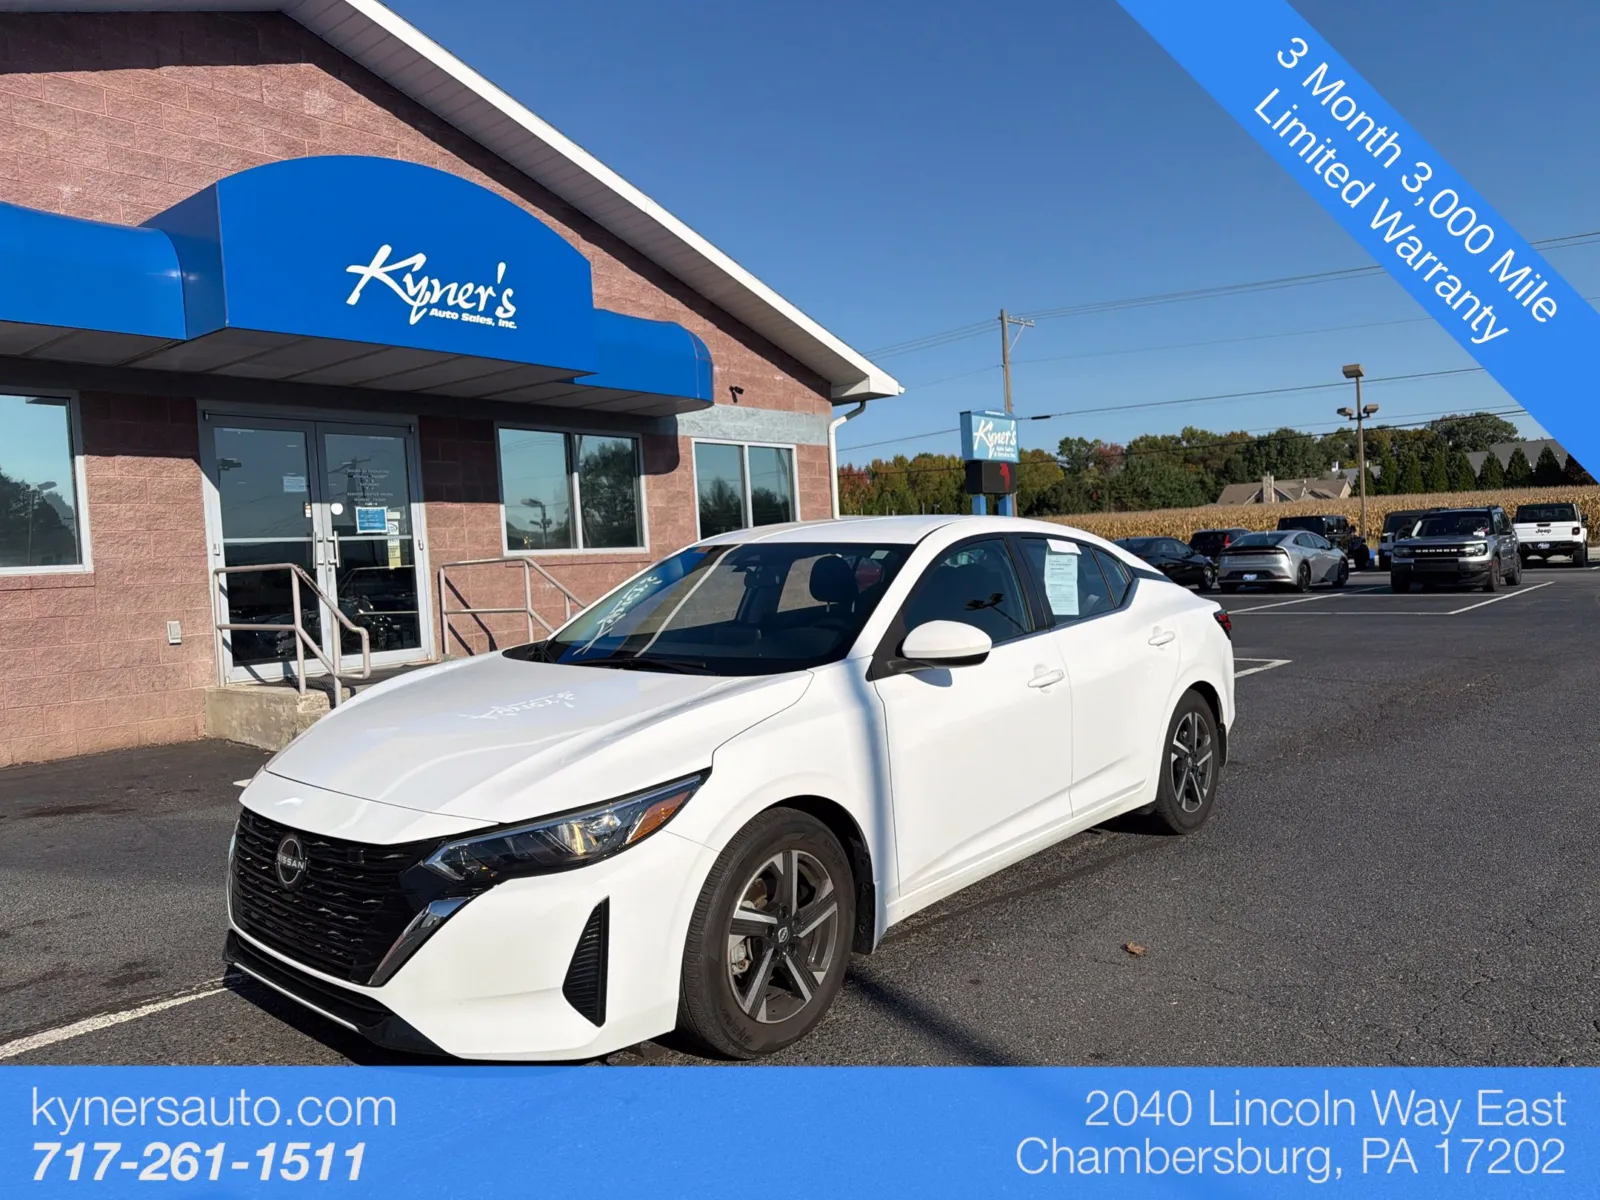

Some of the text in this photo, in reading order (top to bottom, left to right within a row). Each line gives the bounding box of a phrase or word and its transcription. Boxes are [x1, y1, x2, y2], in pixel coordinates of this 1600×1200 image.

[346, 244, 517, 325] Kyner's
[429, 308, 517, 329] Auto Sales, Inc.
[973, 420, 1016, 459] Kyner's
